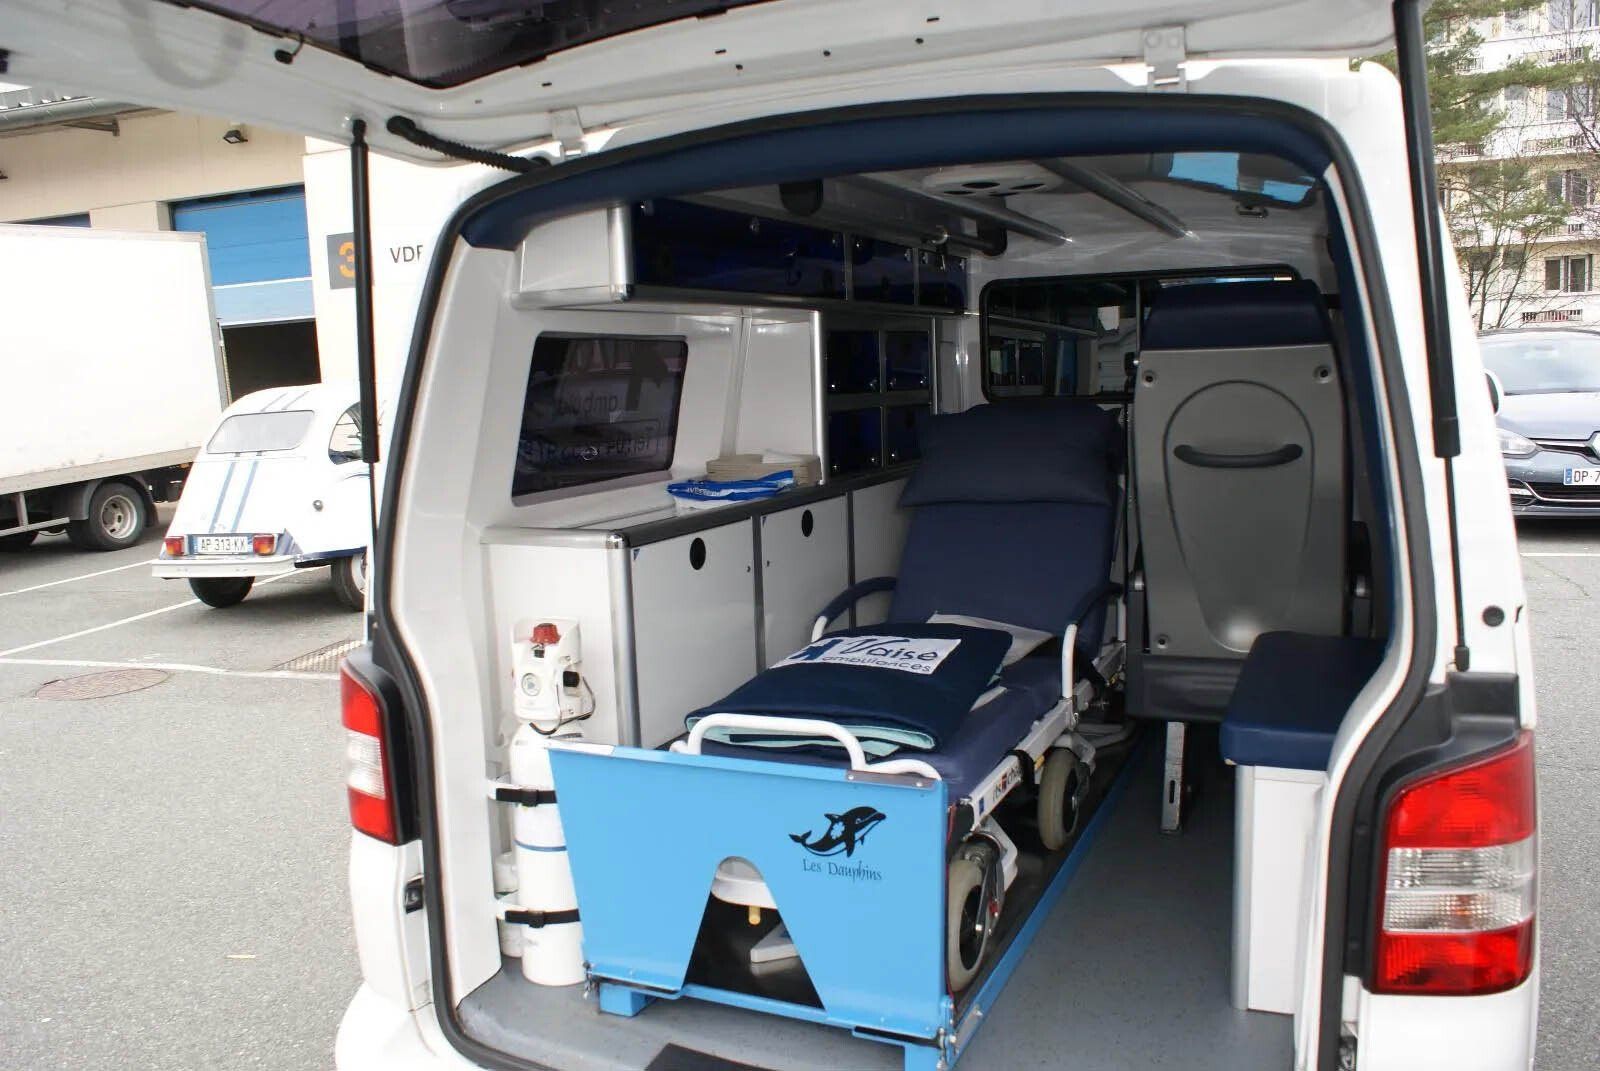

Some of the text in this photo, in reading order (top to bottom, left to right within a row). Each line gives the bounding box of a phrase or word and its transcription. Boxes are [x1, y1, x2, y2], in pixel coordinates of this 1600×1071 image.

[839, 638, 939, 661] Vaise
[821, 655, 931, 673] ambulances
[802, 858, 883, 883] Les Dauphins
